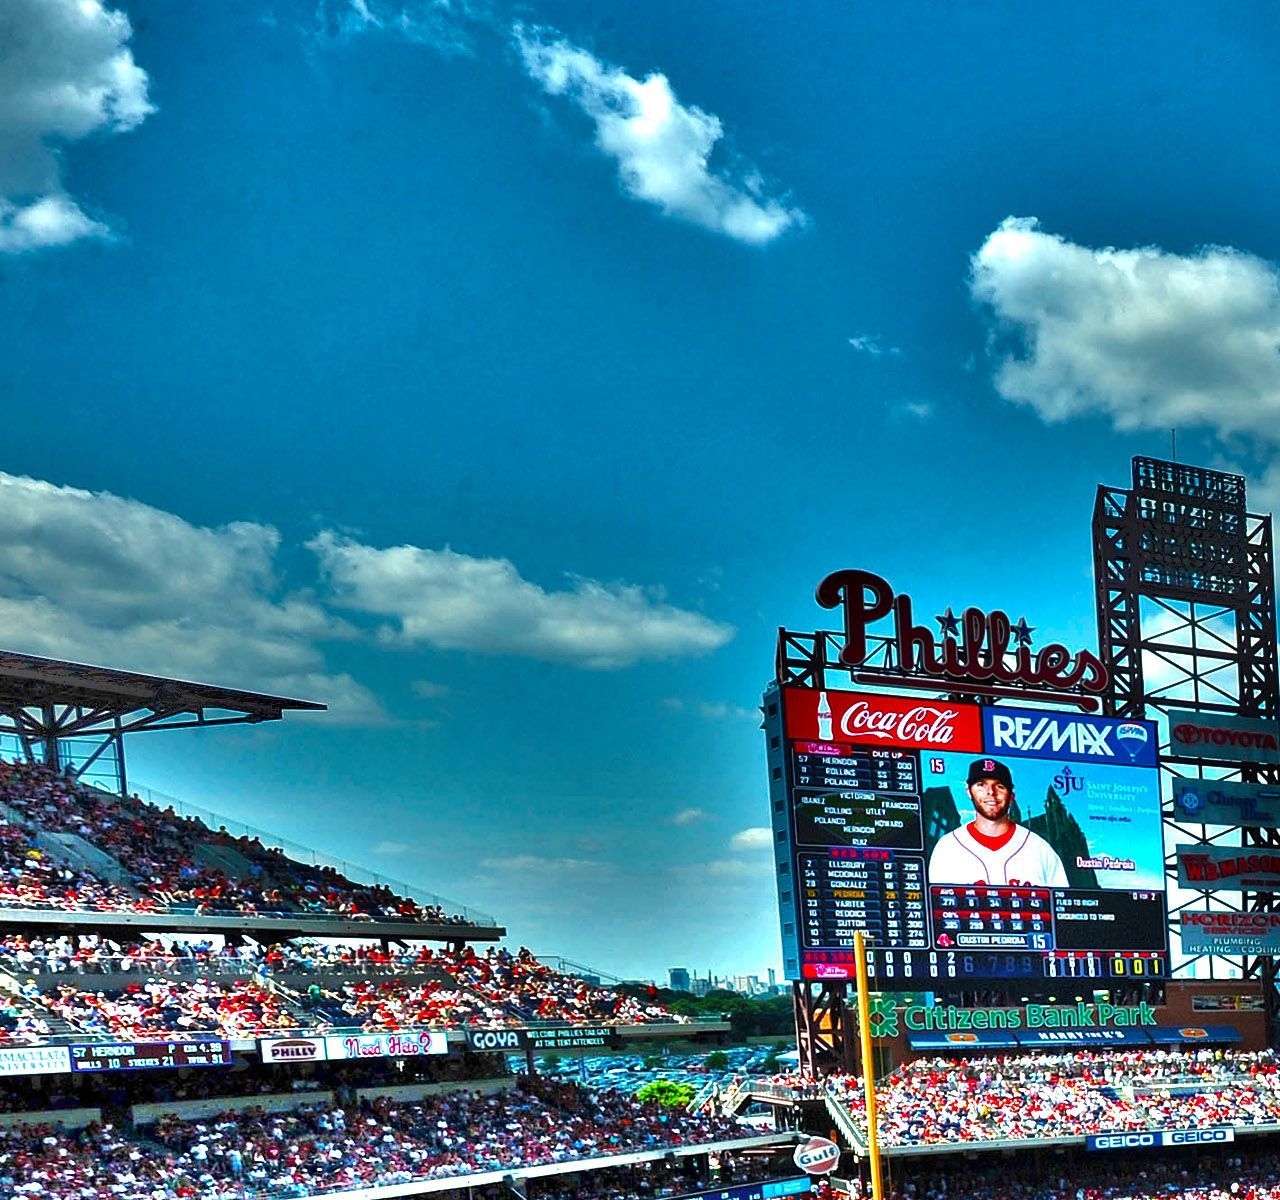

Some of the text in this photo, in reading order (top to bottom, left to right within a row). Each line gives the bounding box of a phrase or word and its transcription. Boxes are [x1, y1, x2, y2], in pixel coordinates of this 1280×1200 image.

[815, 568, 1110, 693] Phillies
[841, 701, 958, 744] Coca-Cola
[992, 715, 1116, 756] RE/MAX
[1200, 728, 1277, 751] TOYOTA
[825, 768, 856, 776] ROLLINS
[931, 758, 944, 773] 15
[825, 778, 858, 786] POLANCO
[824, 807, 852, 815] ROLLINS
[814, 817, 846, 825] POLANCO
[874, 820, 903, 828] HOWARD
[843, 826, 875, 834] HERNDON
[1077, 856, 1134, 869] Dustin Pedroia
[834, 890, 865, 898] PEDROIA
[835, 900, 865, 908] VARITEK
[835, 910, 866, 918] REDDICK
[1032, 934, 1046, 948] 15
[1213, 937, 1261, 945] PLUMBING
[1189, 945, 1231, 953] HEATING
[947, 952, 955, 963] 2
[1153, 959, 1159, 974] 1
[904, 1000, 1157, 1030] Citizens Bank Park
[473, 1032, 519, 1049] GOYA
[1038, 1031, 1084, 1040] HARRY
[72, 1044, 176, 1057] 57 HERNDON P
[345, 1036, 382, 1058] Need
[108, 1059, 120, 1069] 10
[162, 1056, 174, 1066] 21
[1095, 1134, 1154, 1148] GEICO
[1171, 1130, 1226, 1143] GEICO
[799, 1144, 837, 1165] Gulf
